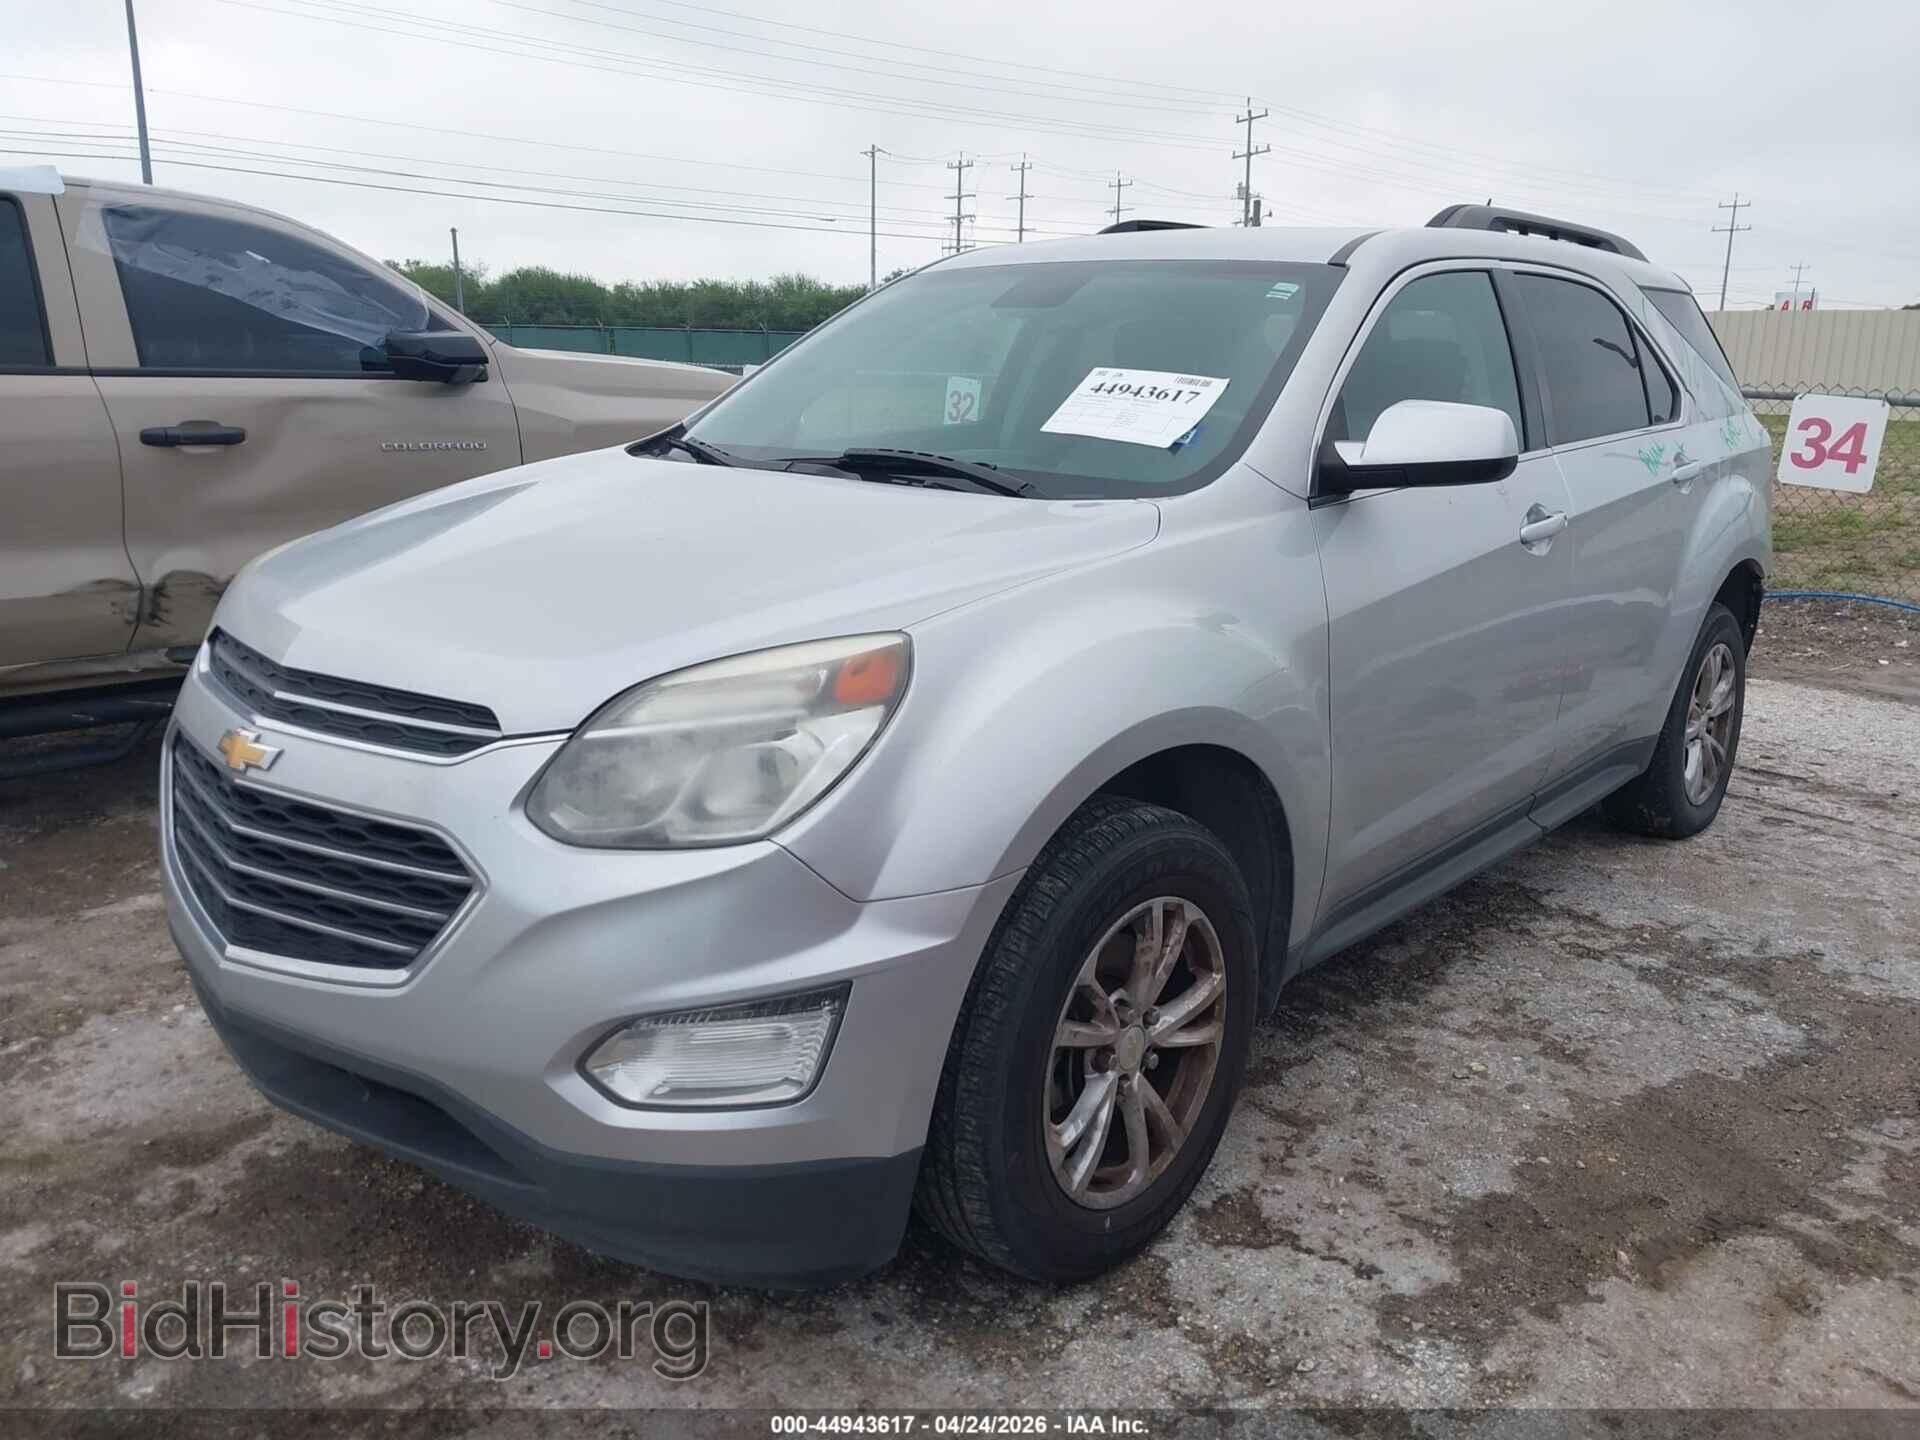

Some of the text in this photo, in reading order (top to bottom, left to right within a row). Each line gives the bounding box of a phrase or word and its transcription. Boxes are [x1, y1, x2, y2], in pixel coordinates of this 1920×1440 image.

[947, 389, 977, 422] 32
[1090, 381, 1201, 404] 44943617
[1790, 417, 1868, 473] 34
